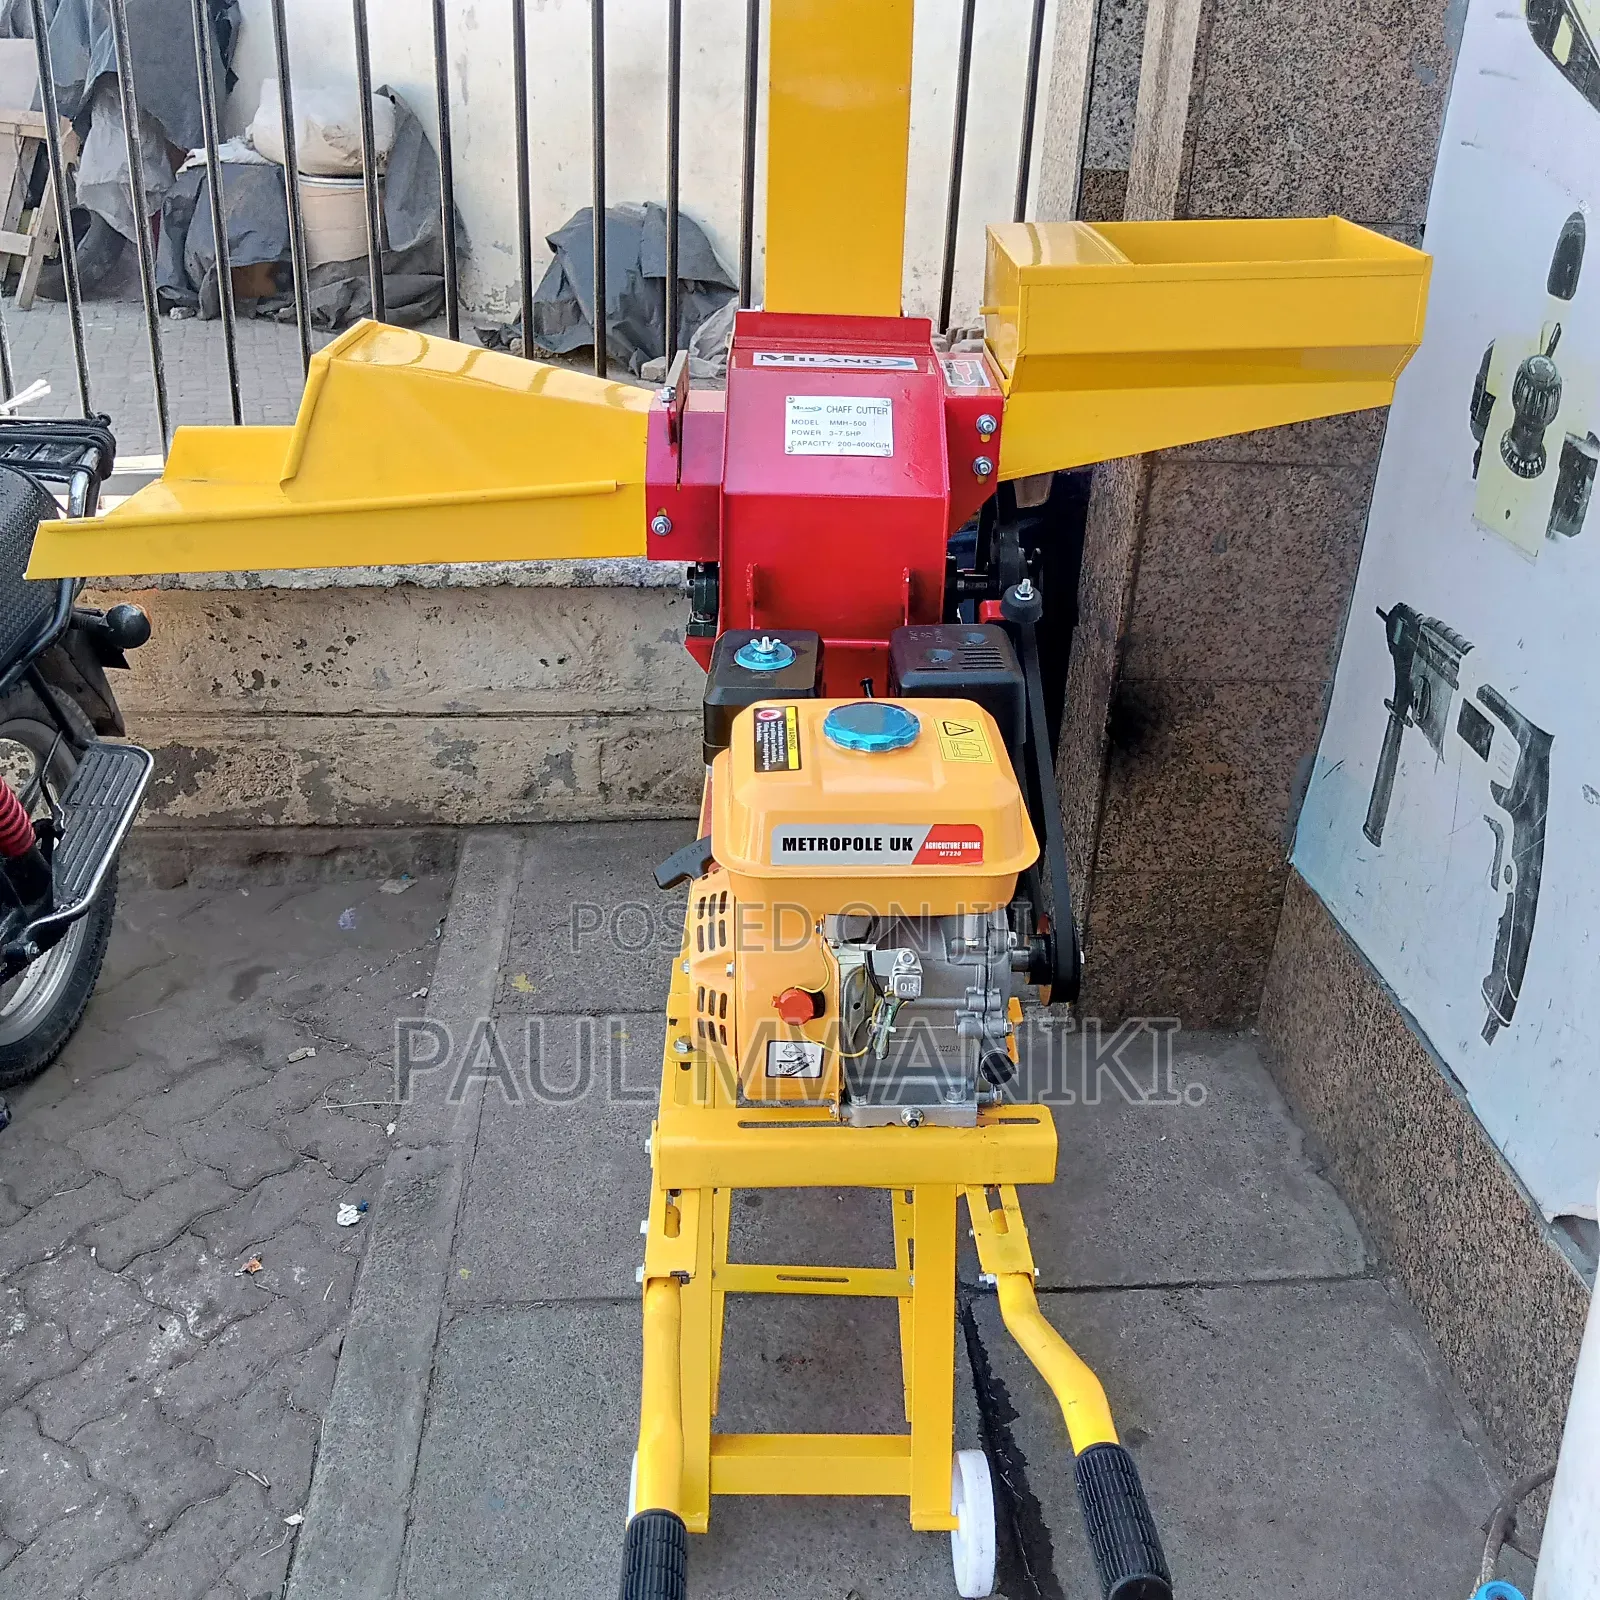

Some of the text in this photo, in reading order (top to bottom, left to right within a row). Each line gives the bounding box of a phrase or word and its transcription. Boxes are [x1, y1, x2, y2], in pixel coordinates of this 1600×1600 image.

[826, 405, 853, 414] CHAFF
[856, 406, 888, 415] CUTTER
[837, 441, 890, 449] 200-400KG/H
[788, 727, 796, 750] WARNING
[782, 837, 913, 852] METROPOLE UK
[925, 841, 981, 850] AGRICULTURE ENGINE
[672, 844, 705, 868] START
[900, 982, 916, 993] OR
